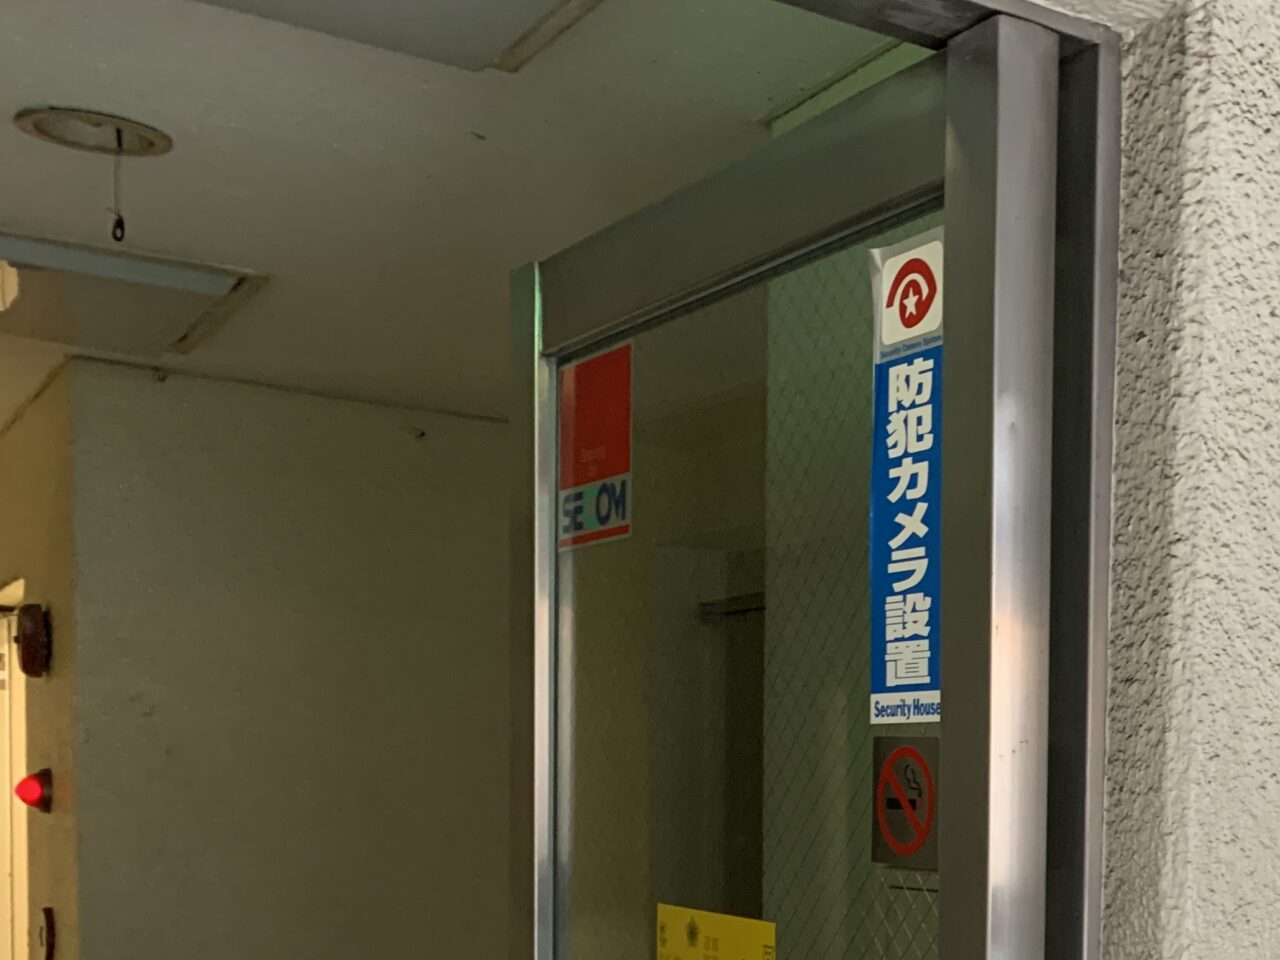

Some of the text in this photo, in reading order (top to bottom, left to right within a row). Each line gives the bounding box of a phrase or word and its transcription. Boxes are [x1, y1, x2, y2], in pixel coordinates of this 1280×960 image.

[886, 356, 935, 688] 防犯カメラ設置
[874, 697, 941, 720] Security House
